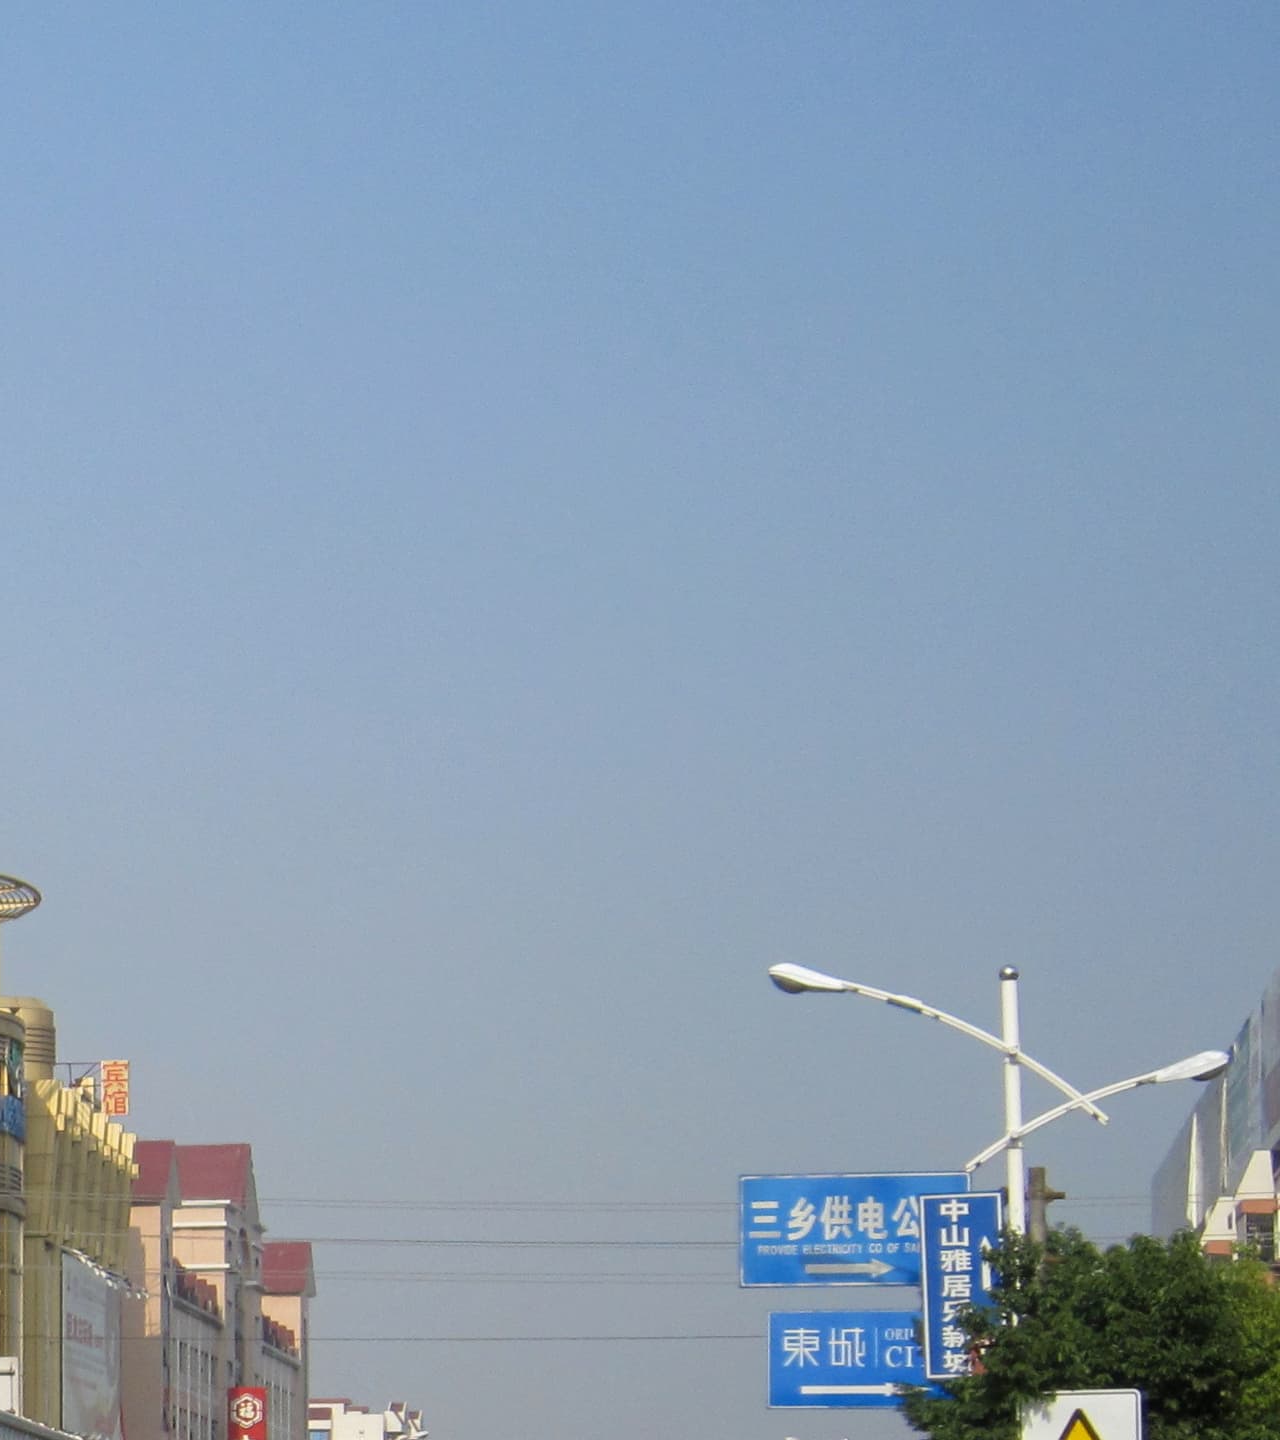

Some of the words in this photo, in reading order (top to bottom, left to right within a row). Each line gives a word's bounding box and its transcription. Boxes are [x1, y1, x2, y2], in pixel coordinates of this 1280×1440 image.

[103, 1061, 128, 1114] 宾馆
[887, 1243, 899, 1253] OF
[905, 1242, 920, 1253] SA
[783, 1328, 866, 1367] 東城
